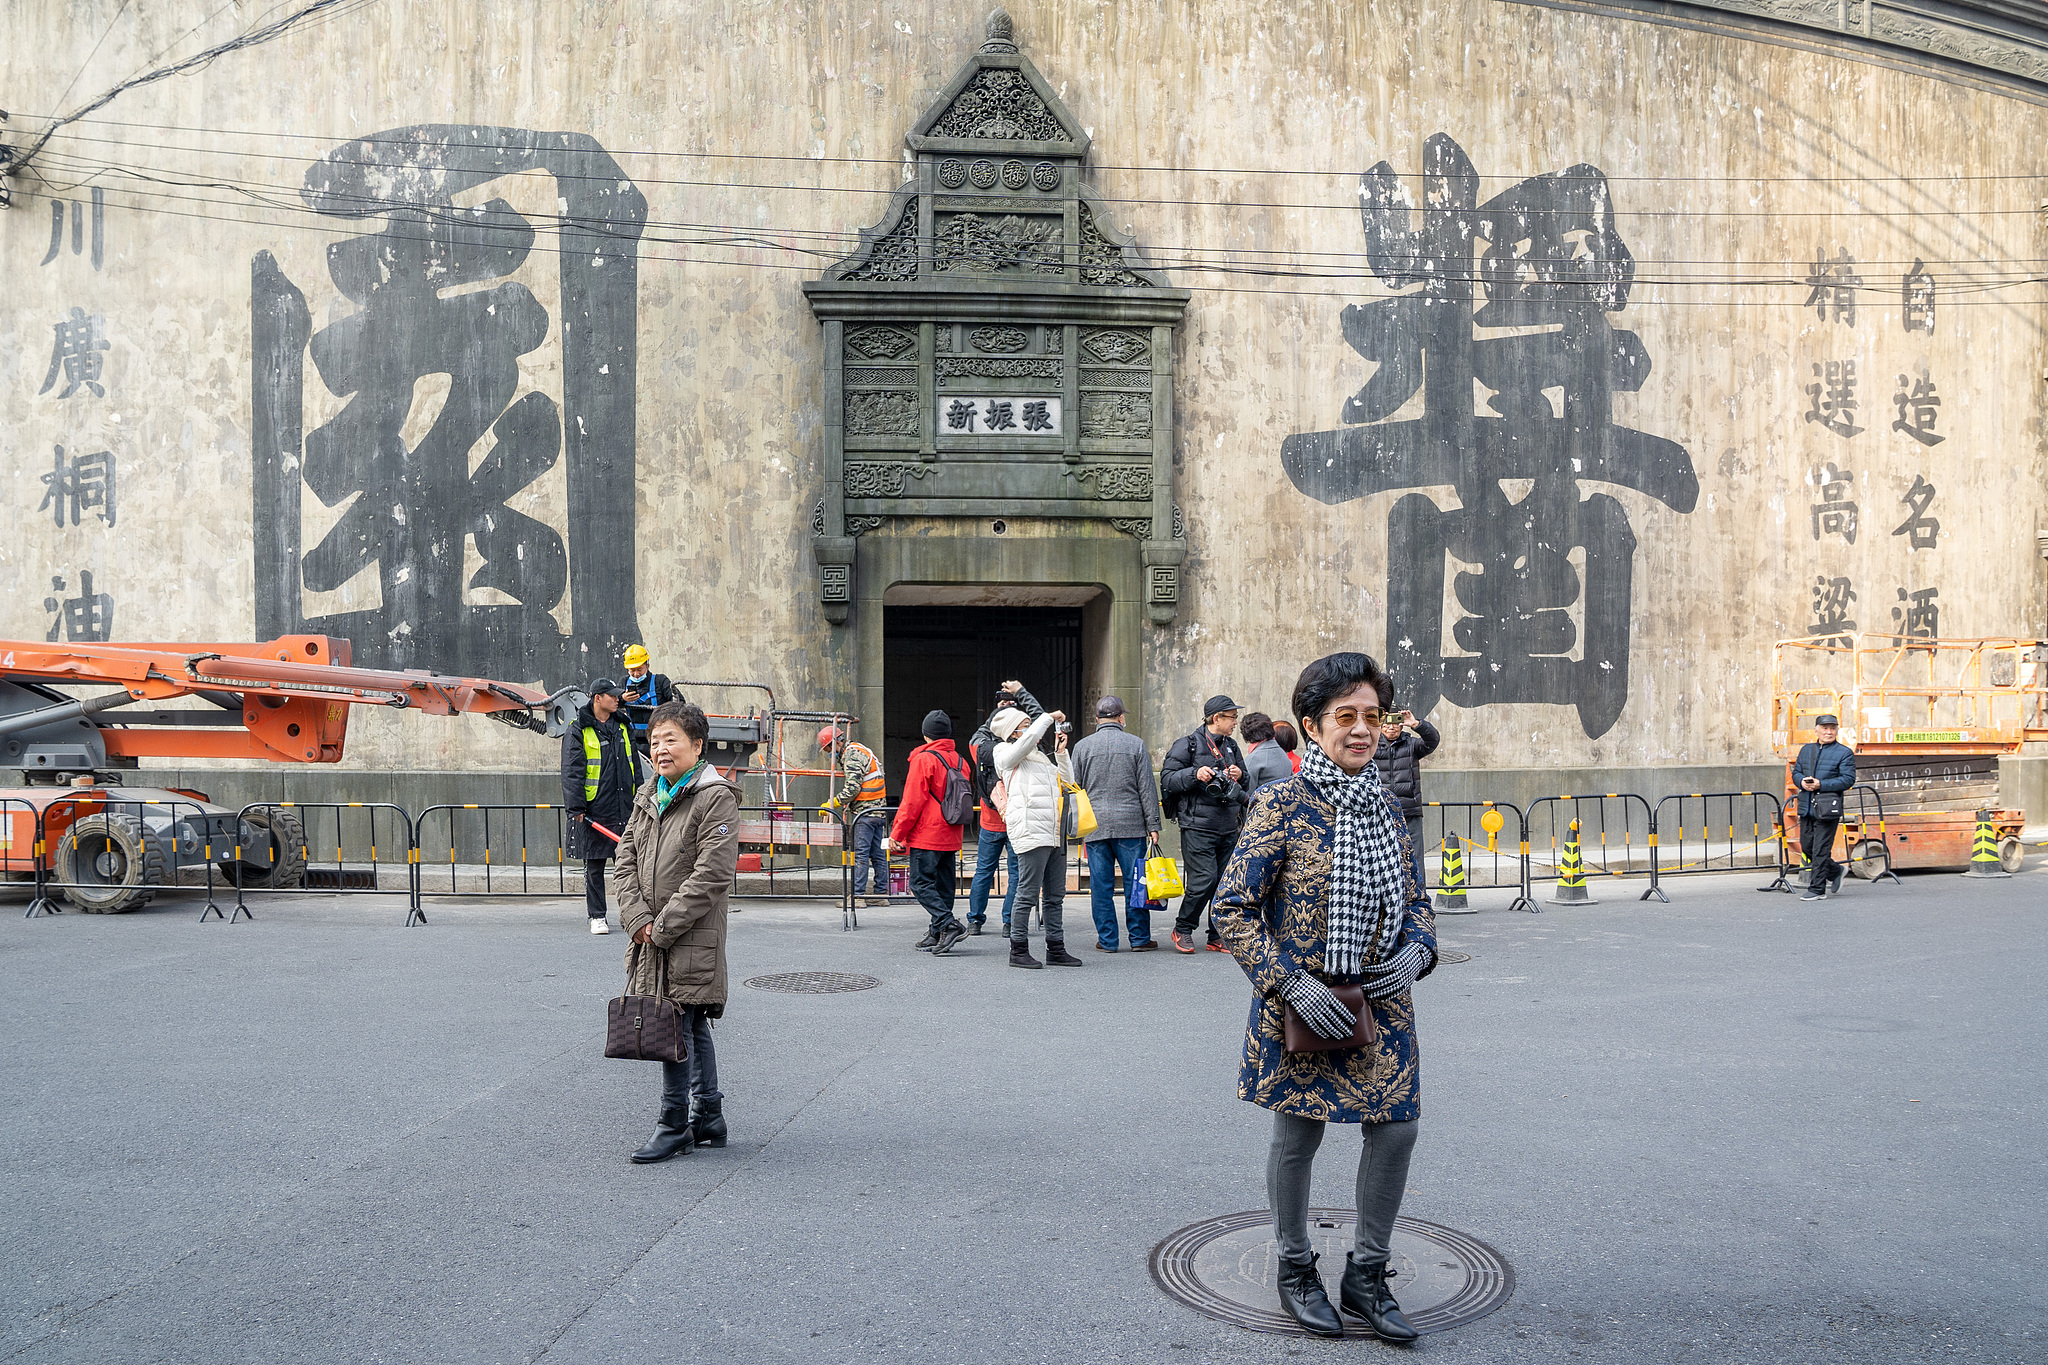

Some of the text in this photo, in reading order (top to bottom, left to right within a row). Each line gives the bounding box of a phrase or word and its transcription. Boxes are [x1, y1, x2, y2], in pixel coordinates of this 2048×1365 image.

[38, 186, 117, 642] 川廣桐油
[1891, 257, 1946, 656] 自造名酒
[0, 651, 15, 669] 4
[1943, 765, 1971, 783] 010
